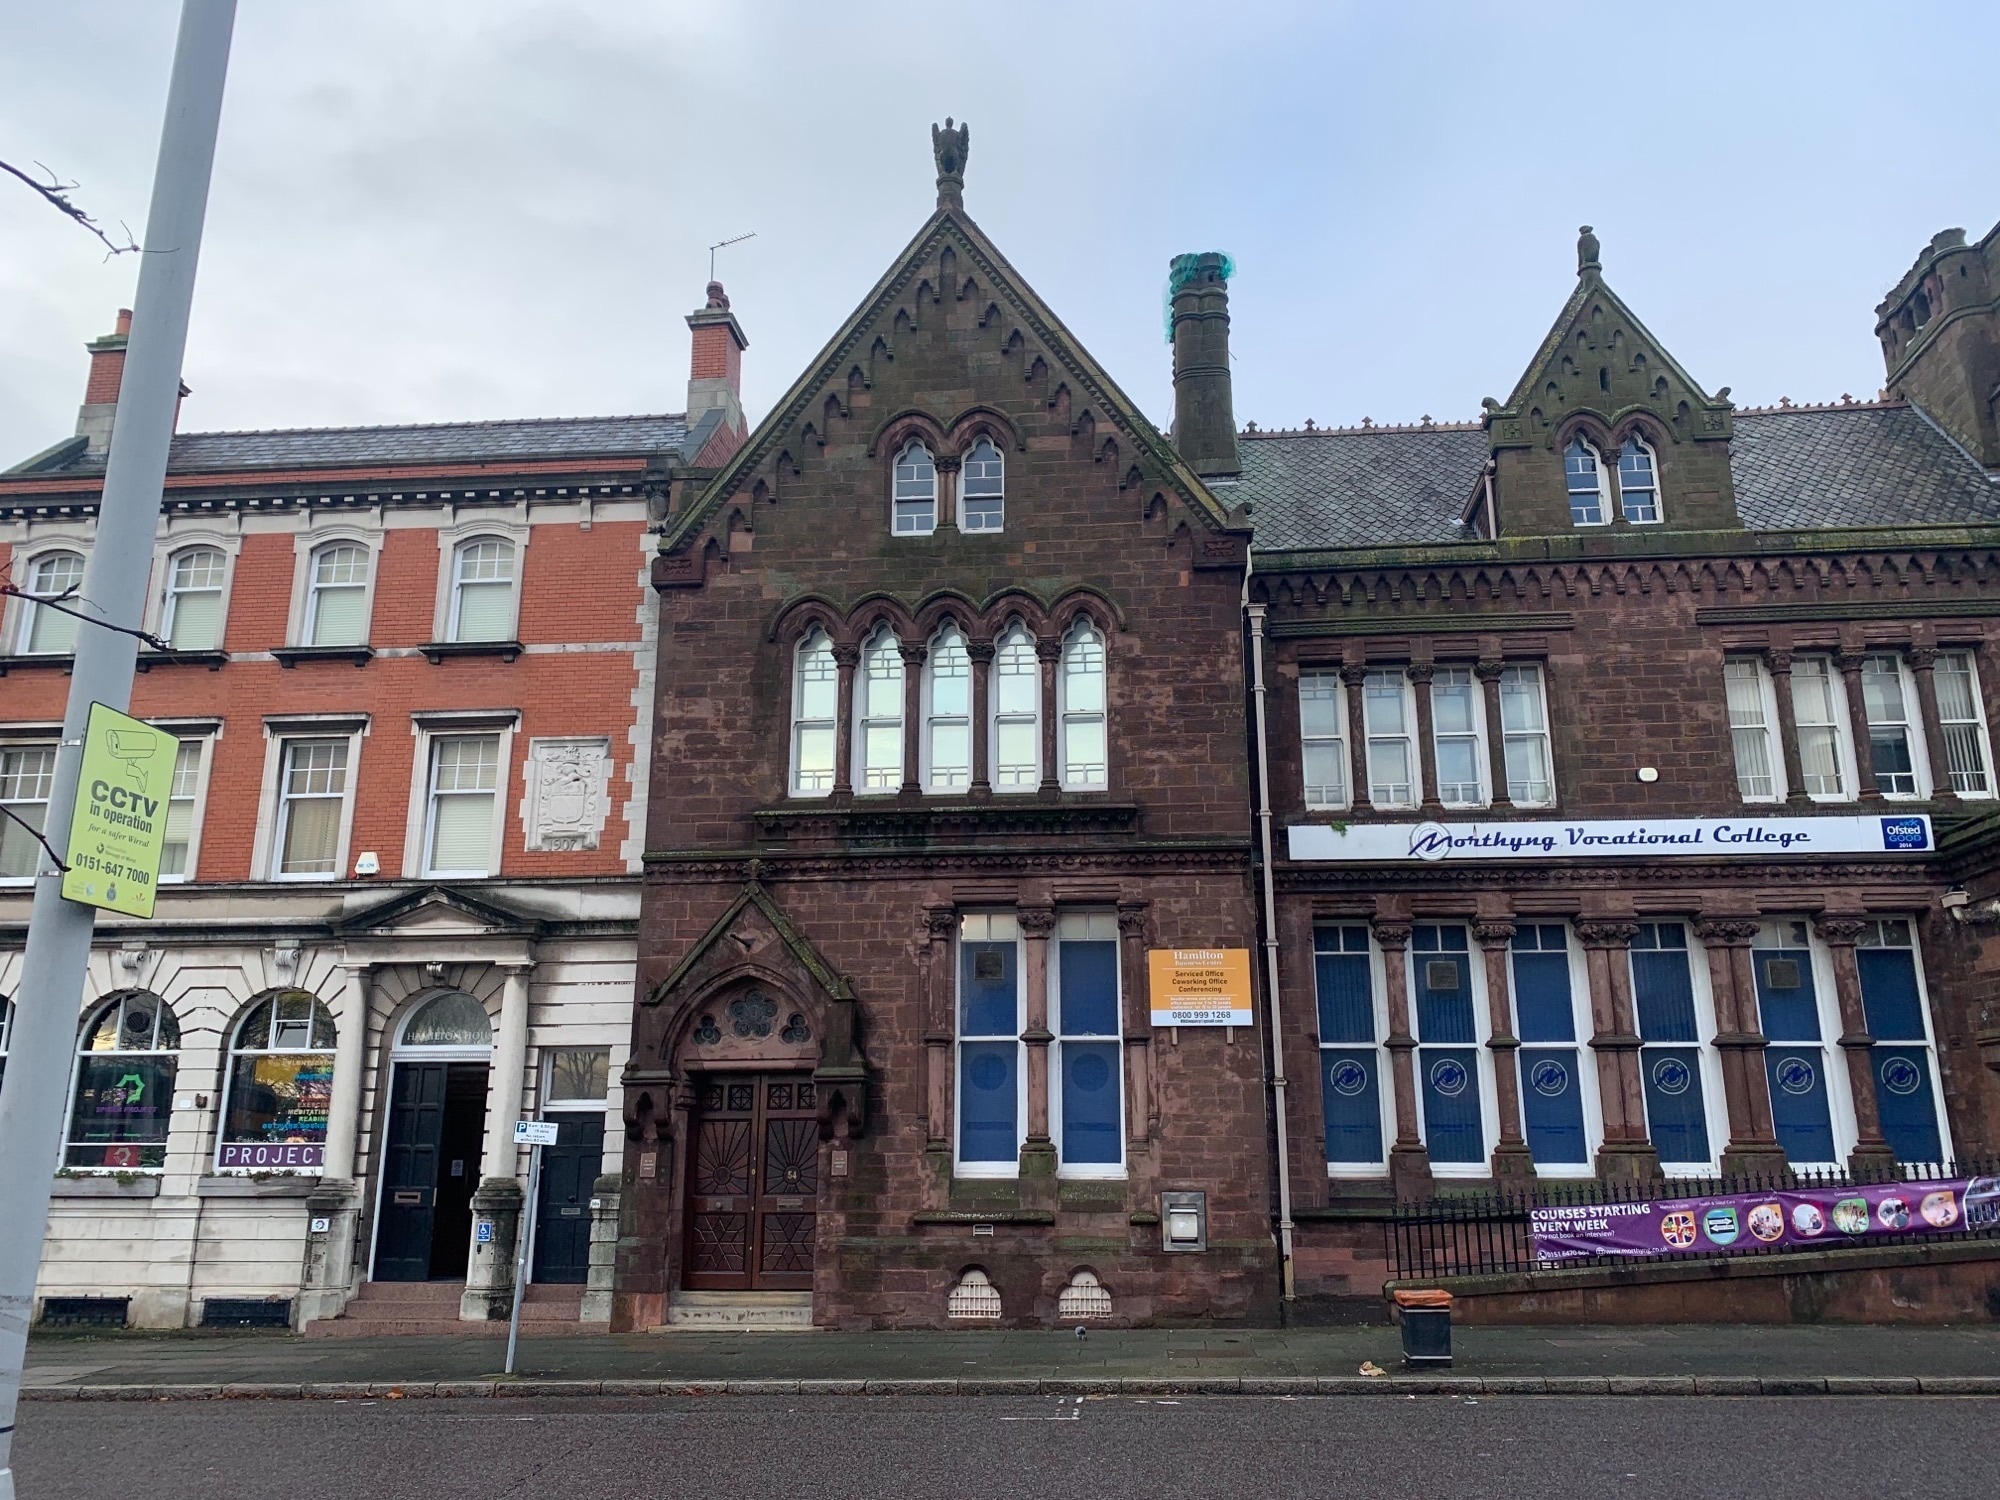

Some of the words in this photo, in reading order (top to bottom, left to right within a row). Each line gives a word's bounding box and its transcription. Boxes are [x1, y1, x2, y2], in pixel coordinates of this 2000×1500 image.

[91, 780, 159, 818] CCTV
[89, 800, 101, 817] in
[103, 808, 153, 834] operation
[1886, 825, 1921, 835] Ofsted
[87, 823, 101, 832] for
[108, 830, 127, 840] safer
[128, 835, 150, 848] Wirral
[1408, 831, 1557, 856] Morthyng
[1564, 827, 1704, 845] Vocational
[1713, 825, 1812, 848] College
[1888, 834, 1922, 842] GOOD
[549, 838, 577, 851] 1907
[76, 853, 124, 878] 0151-647
[127, 867, 150, 885] 7000
[1174, 951, 1224, 960] Hamilton
[1172, 978, 1207, 986] Coworking
[1172, 1011, 1192, 1019] 0800
[1194, 1011, 1209, 1019] 999
[1212, 1011, 1231, 1019] 1268
[407, 1032, 461, 1041] HAMILTON
[464, 1031, 492, 1041] HOUS
[519, 1123, 527, 1132] P
[787, 1170, 797, 1180] 54
[1531, 1208, 1587, 1220] COURSES
[1589, 1203, 1650, 1217] STARTING
[1533, 1220, 1571, 1232] EVERY
[1574, 1219, 1609, 1231] WEEK
[1534, 1232, 1548, 1240] Why
[1585, 1230, 1615, 1238] interview?
